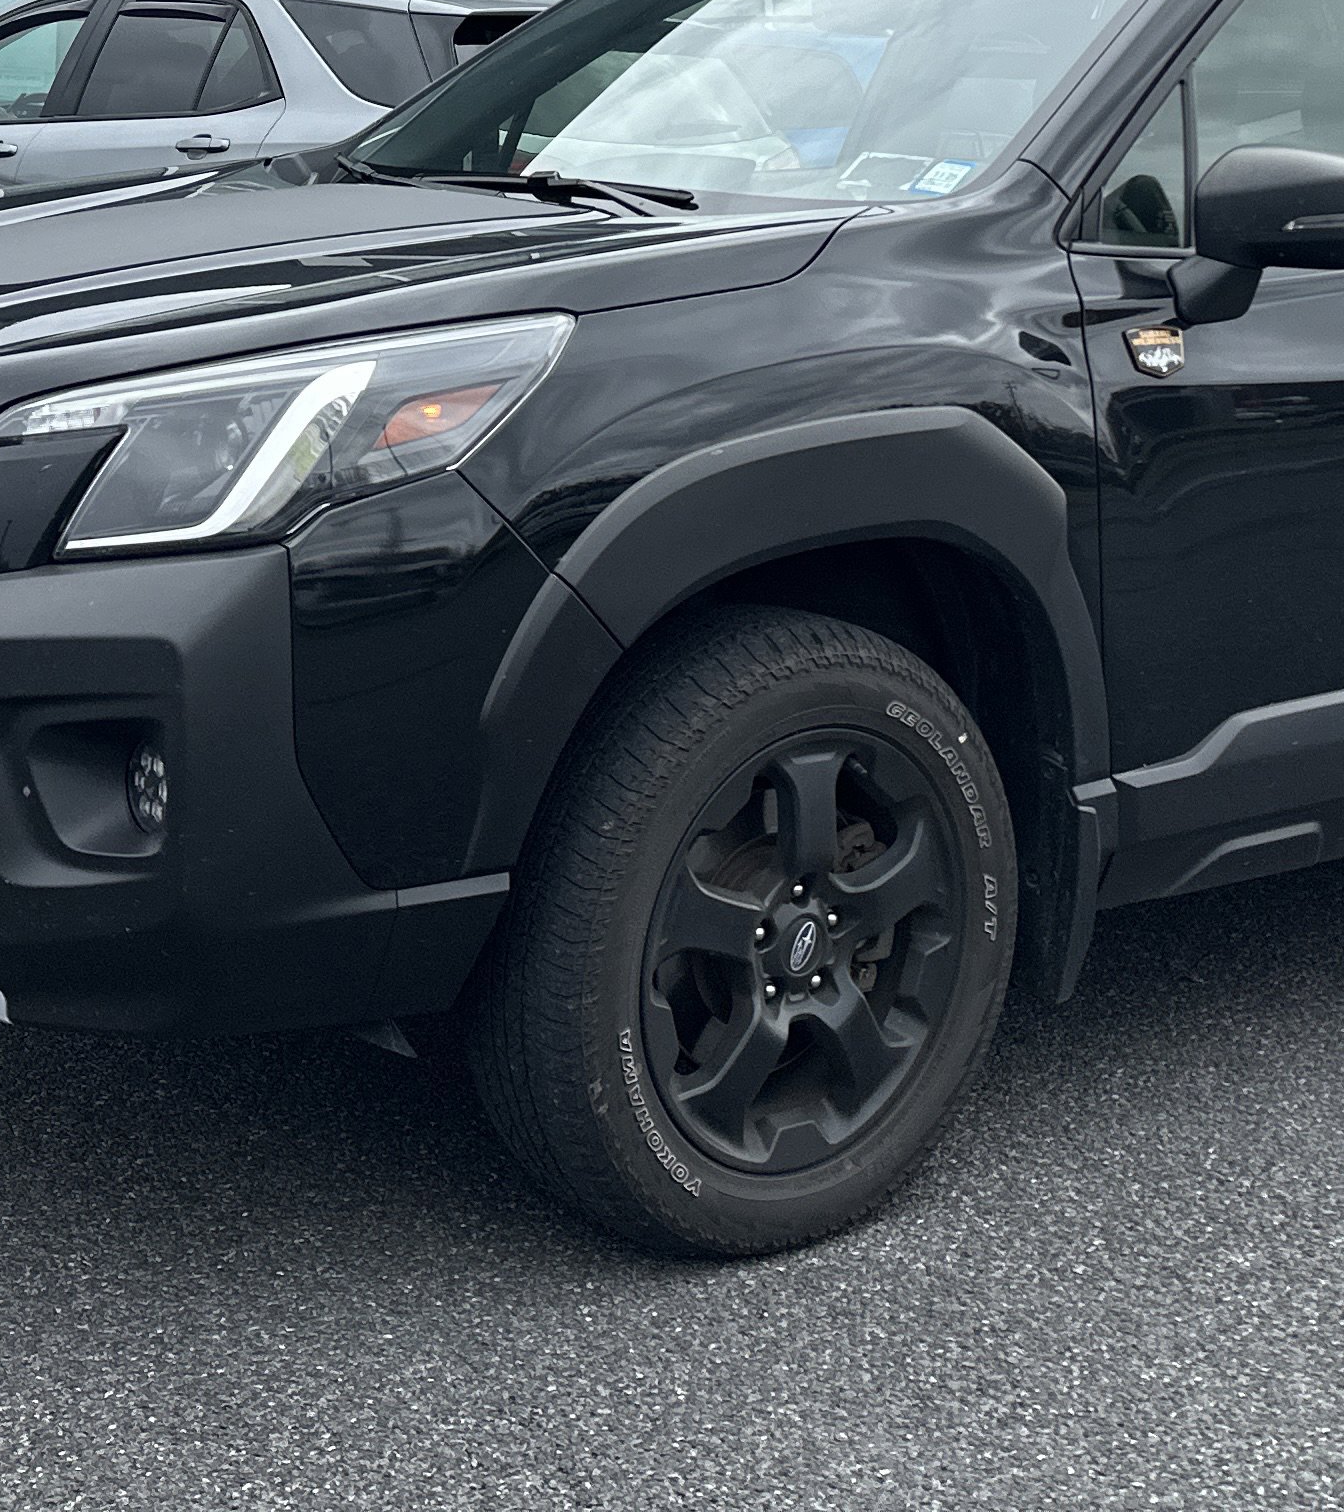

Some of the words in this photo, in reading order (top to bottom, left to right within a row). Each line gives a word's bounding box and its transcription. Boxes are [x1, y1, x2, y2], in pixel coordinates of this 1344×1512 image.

[886, 699, 993, 849] GEOLANDAR
[982, 873, 998, 942] A/T
[619, 1028, 703, 1198] YOKOHAMA
